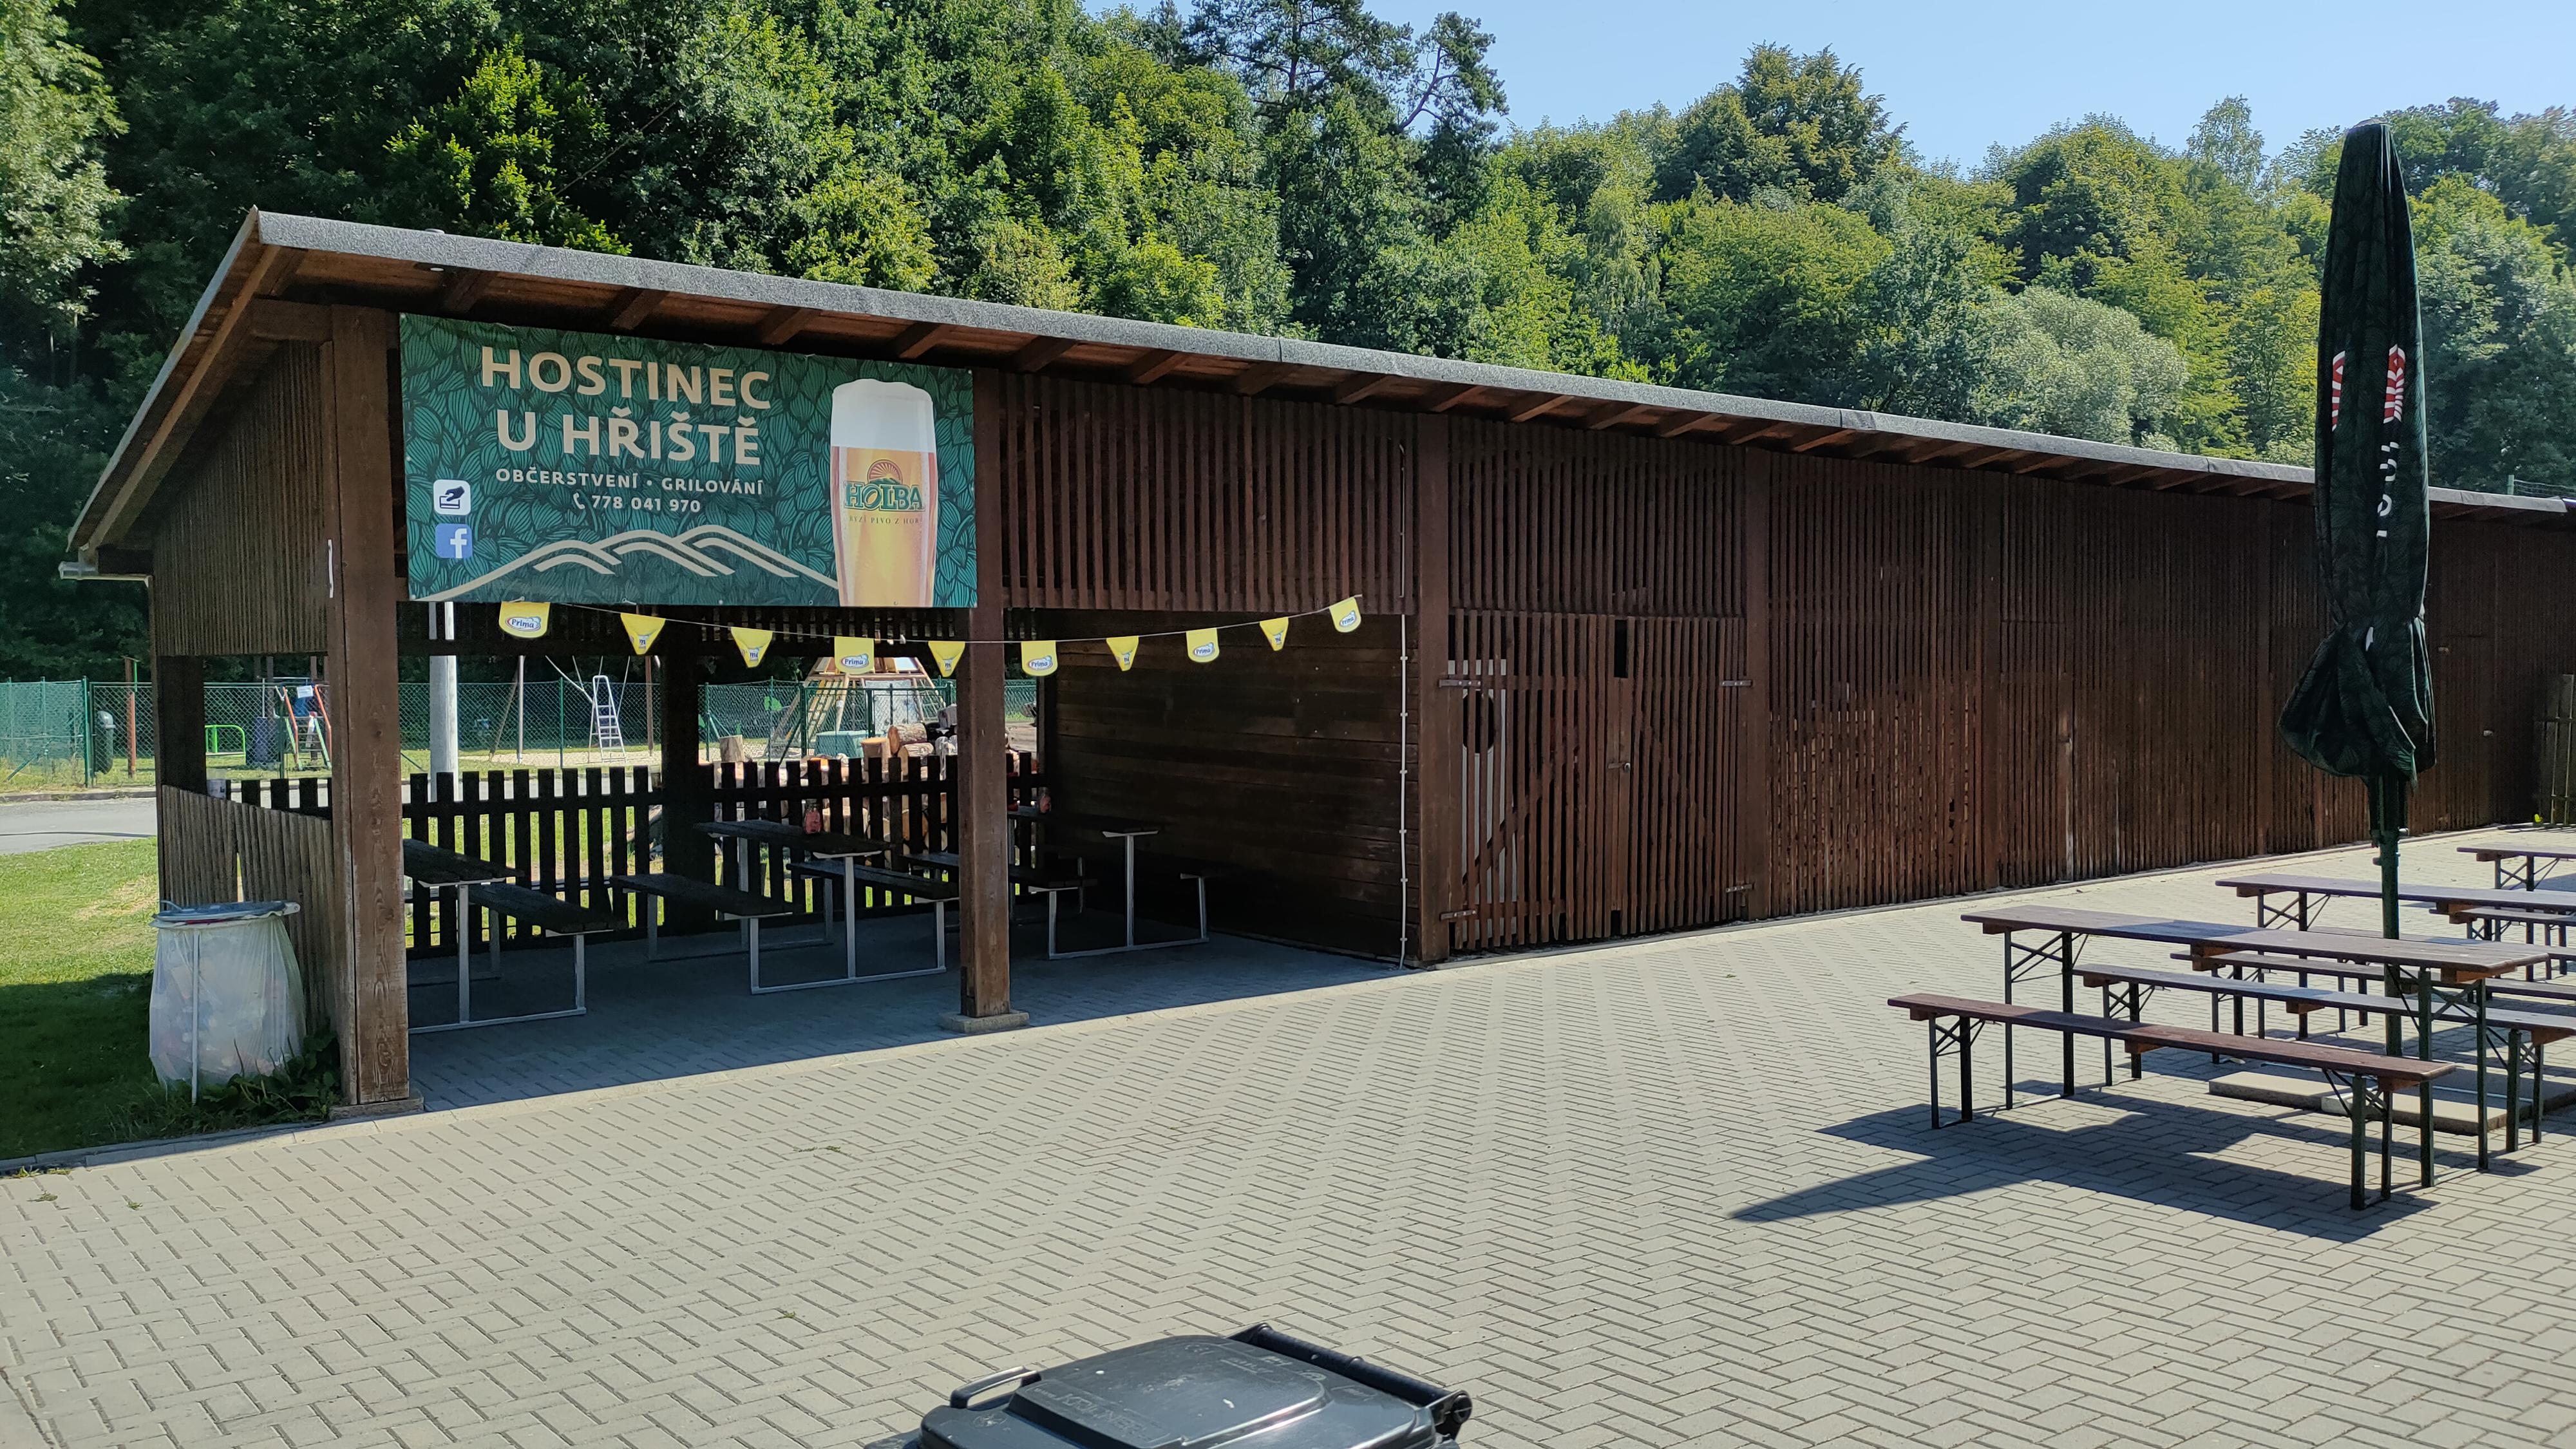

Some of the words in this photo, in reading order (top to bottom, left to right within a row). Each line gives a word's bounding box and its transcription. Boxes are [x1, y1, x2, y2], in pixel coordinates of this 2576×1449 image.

[482, 346, 771, 409] HOSTINEC
[497, 409, 536, 451] U
[563, 406, 761, 465] HŘIŠTĚ
[496, 466, 638, 488] OBČERSTVENÍ
[662, 477, 763, 495] GRILOVÁNÍ
[592, 495, 622, 509] 778
[631, 497, 661, 511] 041
[670, 499, 701, 513] 970
[845, 481, 925, 511] HOLBA
[511, 619, 535, 629] Prima
